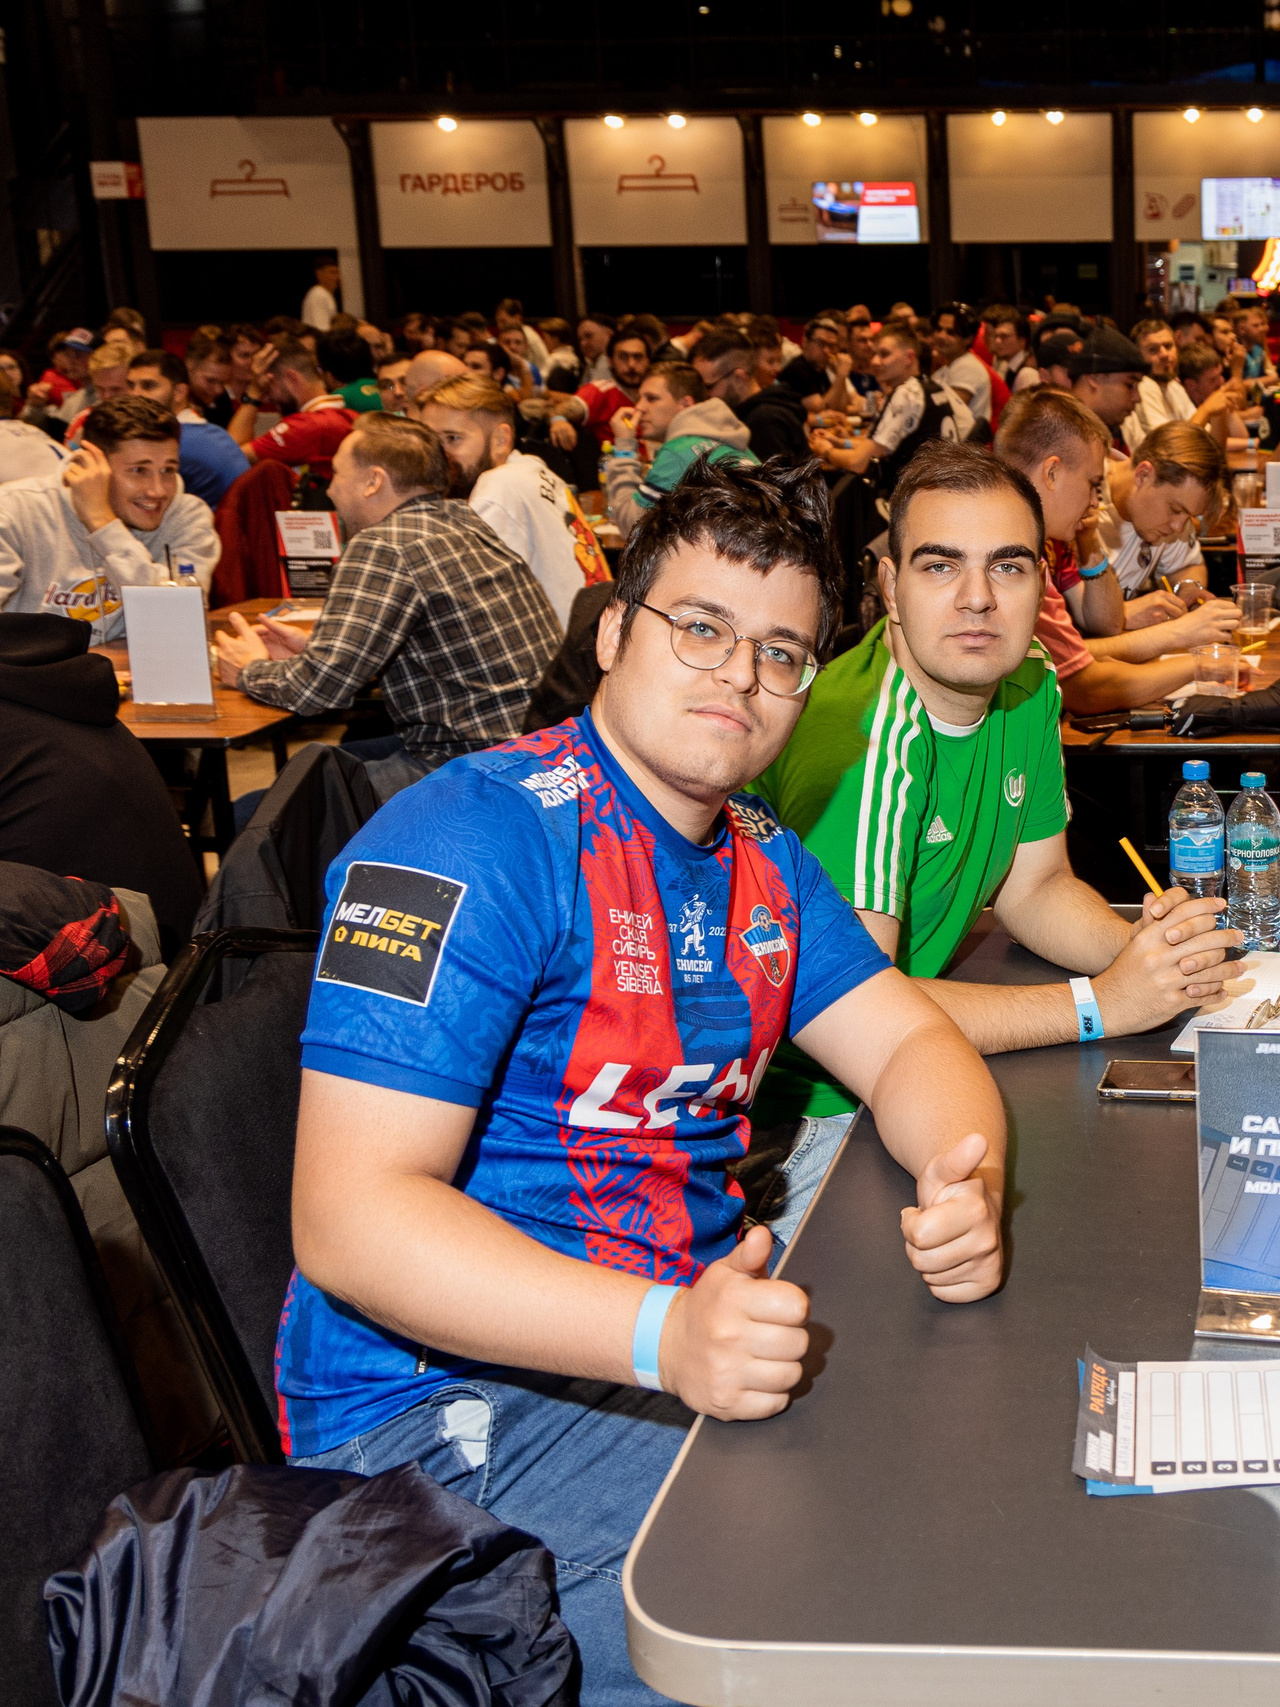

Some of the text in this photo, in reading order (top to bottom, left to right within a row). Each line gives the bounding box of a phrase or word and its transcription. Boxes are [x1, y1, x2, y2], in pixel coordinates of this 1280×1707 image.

[399, 171, 525, 196] ГАРДЕРОБ
[925, 829, 954, 843] adidas
[335, 901, 442, 941] МЕЛБЕТ
[619, 925, 648, 944] СКАЯ
[350, 930, 422, 962] ЛИГА
[612, 939, 656, 960] СИБИРЬ
[676, 957, 713, 973] ЕНИСЕЙ
[617, 976, 664, 995] SIBERIA
[692, 974, 704, 984] ЛЕТ
[1229, 1136, 1252, 1155] И
[1089, 1374, 1107, 1415] РАУНД
